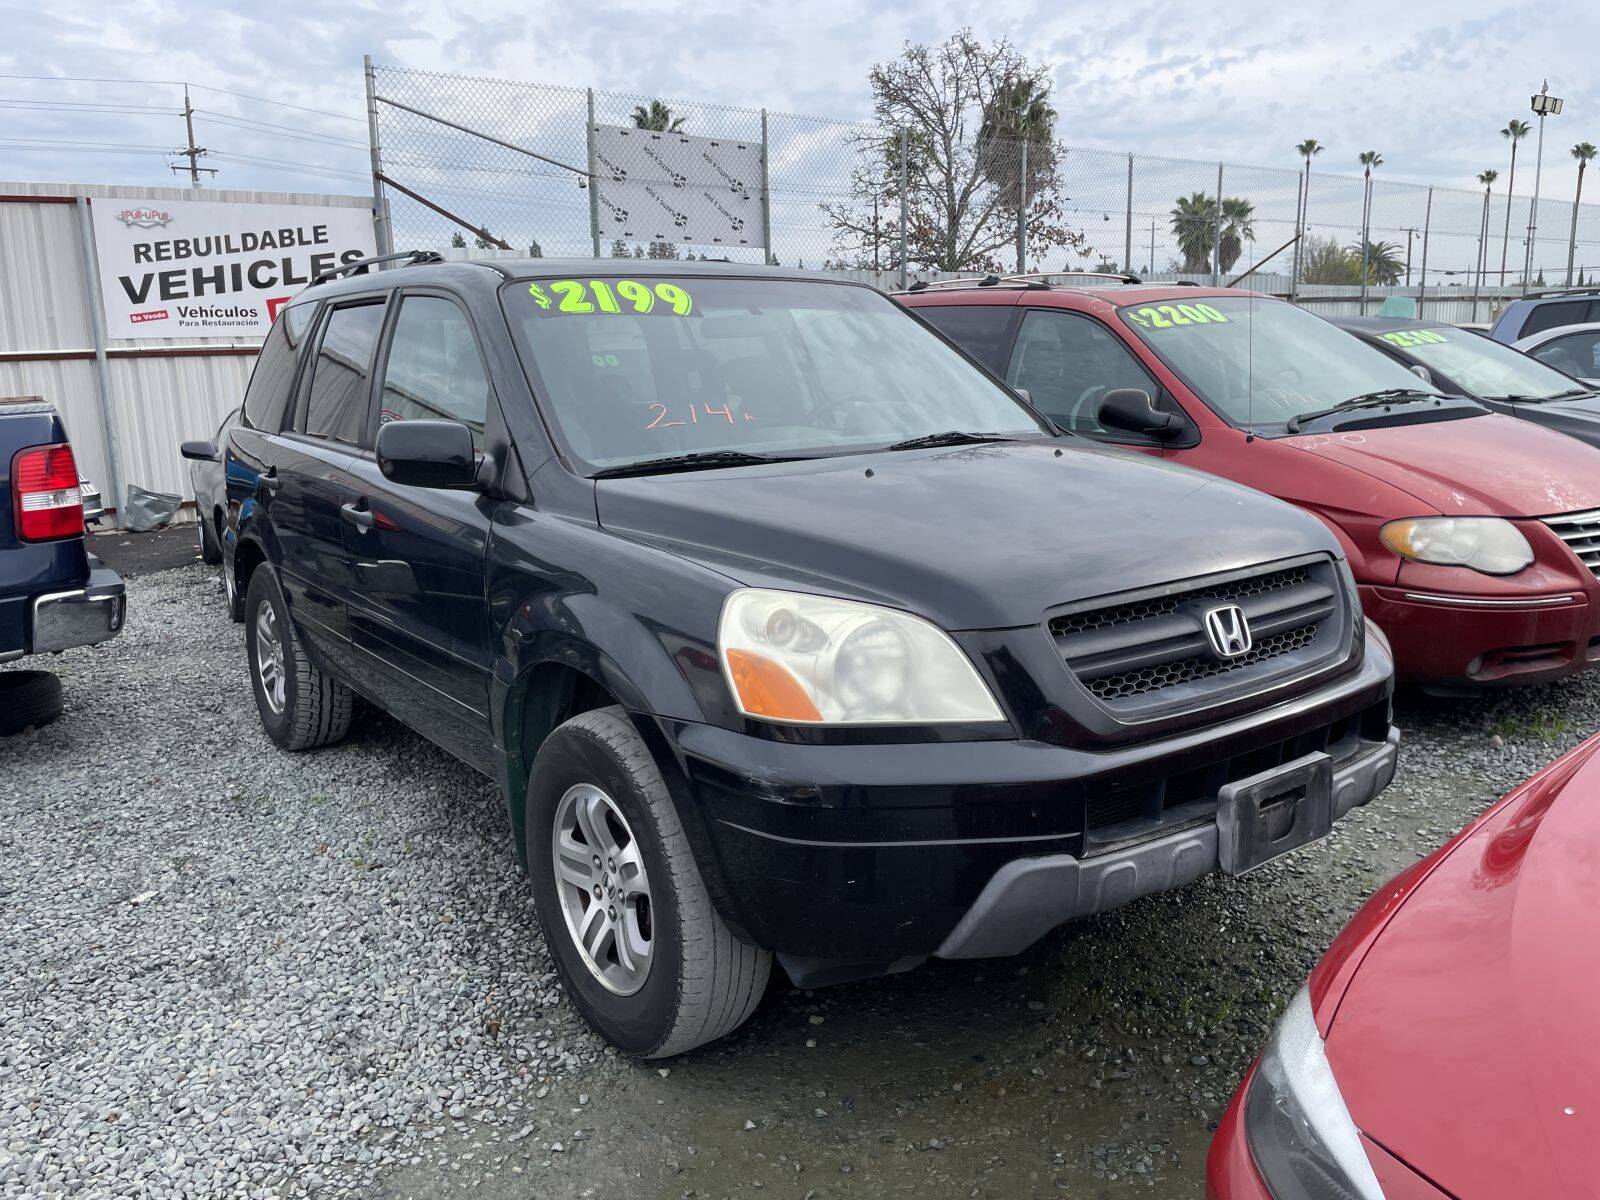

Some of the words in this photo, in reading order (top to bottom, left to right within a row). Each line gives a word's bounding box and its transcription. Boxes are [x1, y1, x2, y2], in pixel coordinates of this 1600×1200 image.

[133, 224, 329, 264] REBUILDABLE
[117, 249, 367, 305] VEHICLES
[176, 304, 258, 318] Vehículos
[528, 280, 693, 316] $2199
[179, 319, 199, 327] Para
[201, 318, 259, 327] Restauración
[1127, 303, 1229, 328] $2200
